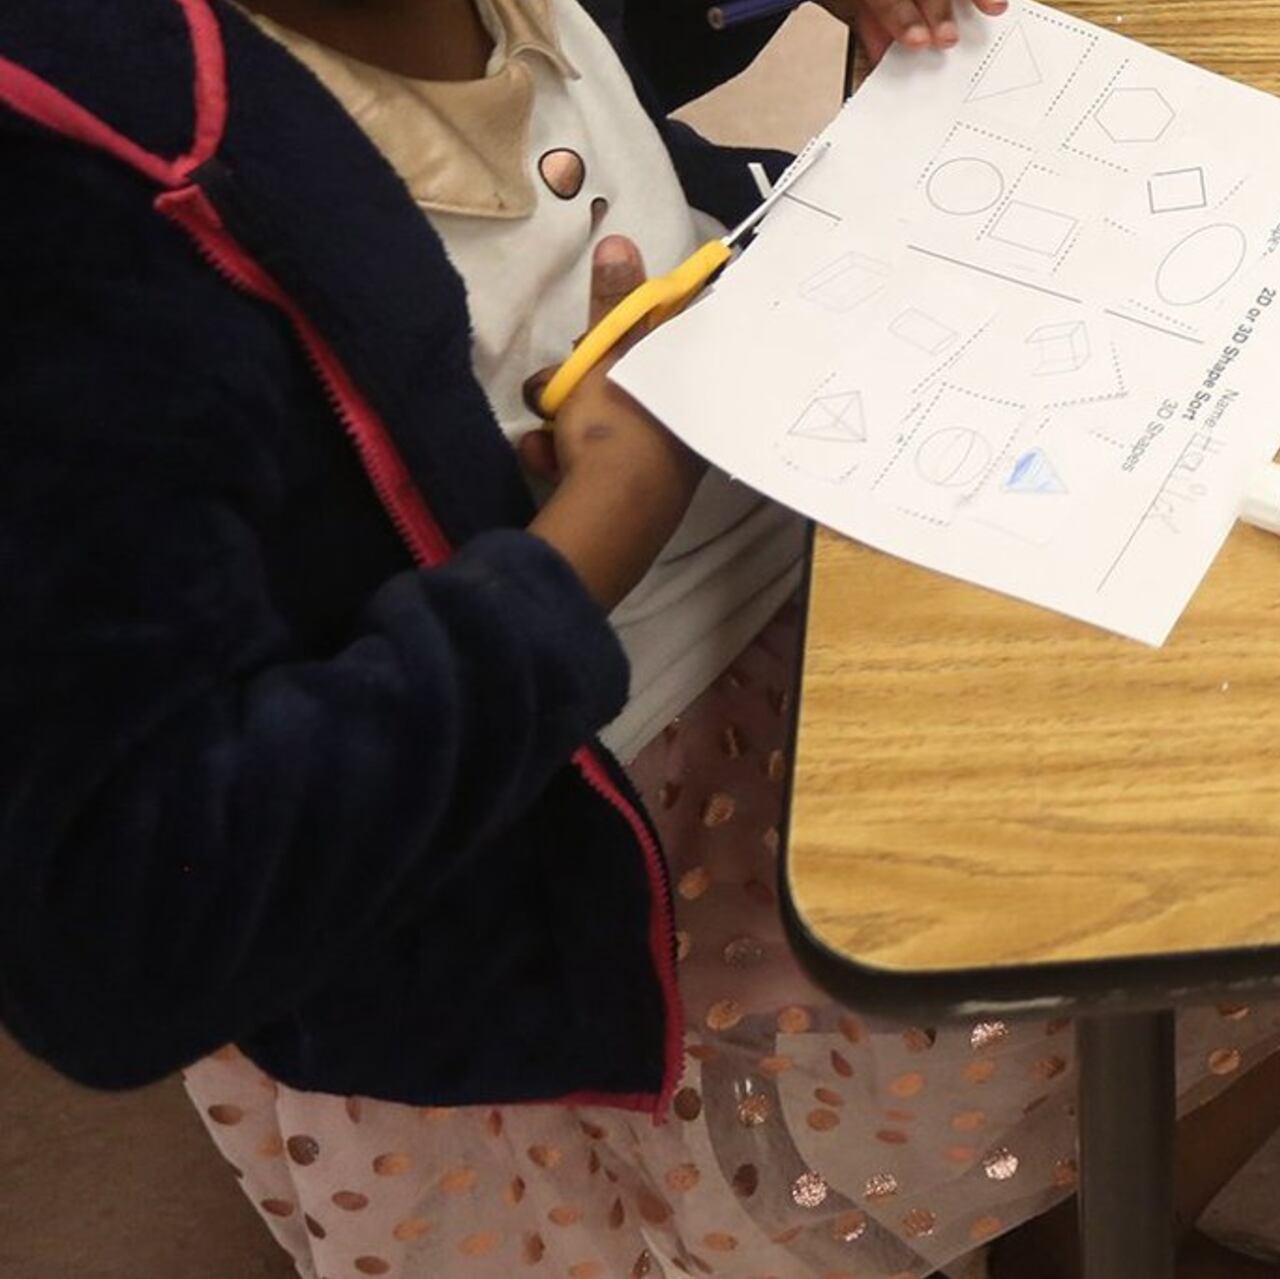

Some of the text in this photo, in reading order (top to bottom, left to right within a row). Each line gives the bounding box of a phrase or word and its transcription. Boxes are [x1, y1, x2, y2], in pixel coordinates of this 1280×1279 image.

[1182, 287, 1277, 420] 2D or 3D Shape Sort
[1122, 399, 1178, 472] 3D Shapes
